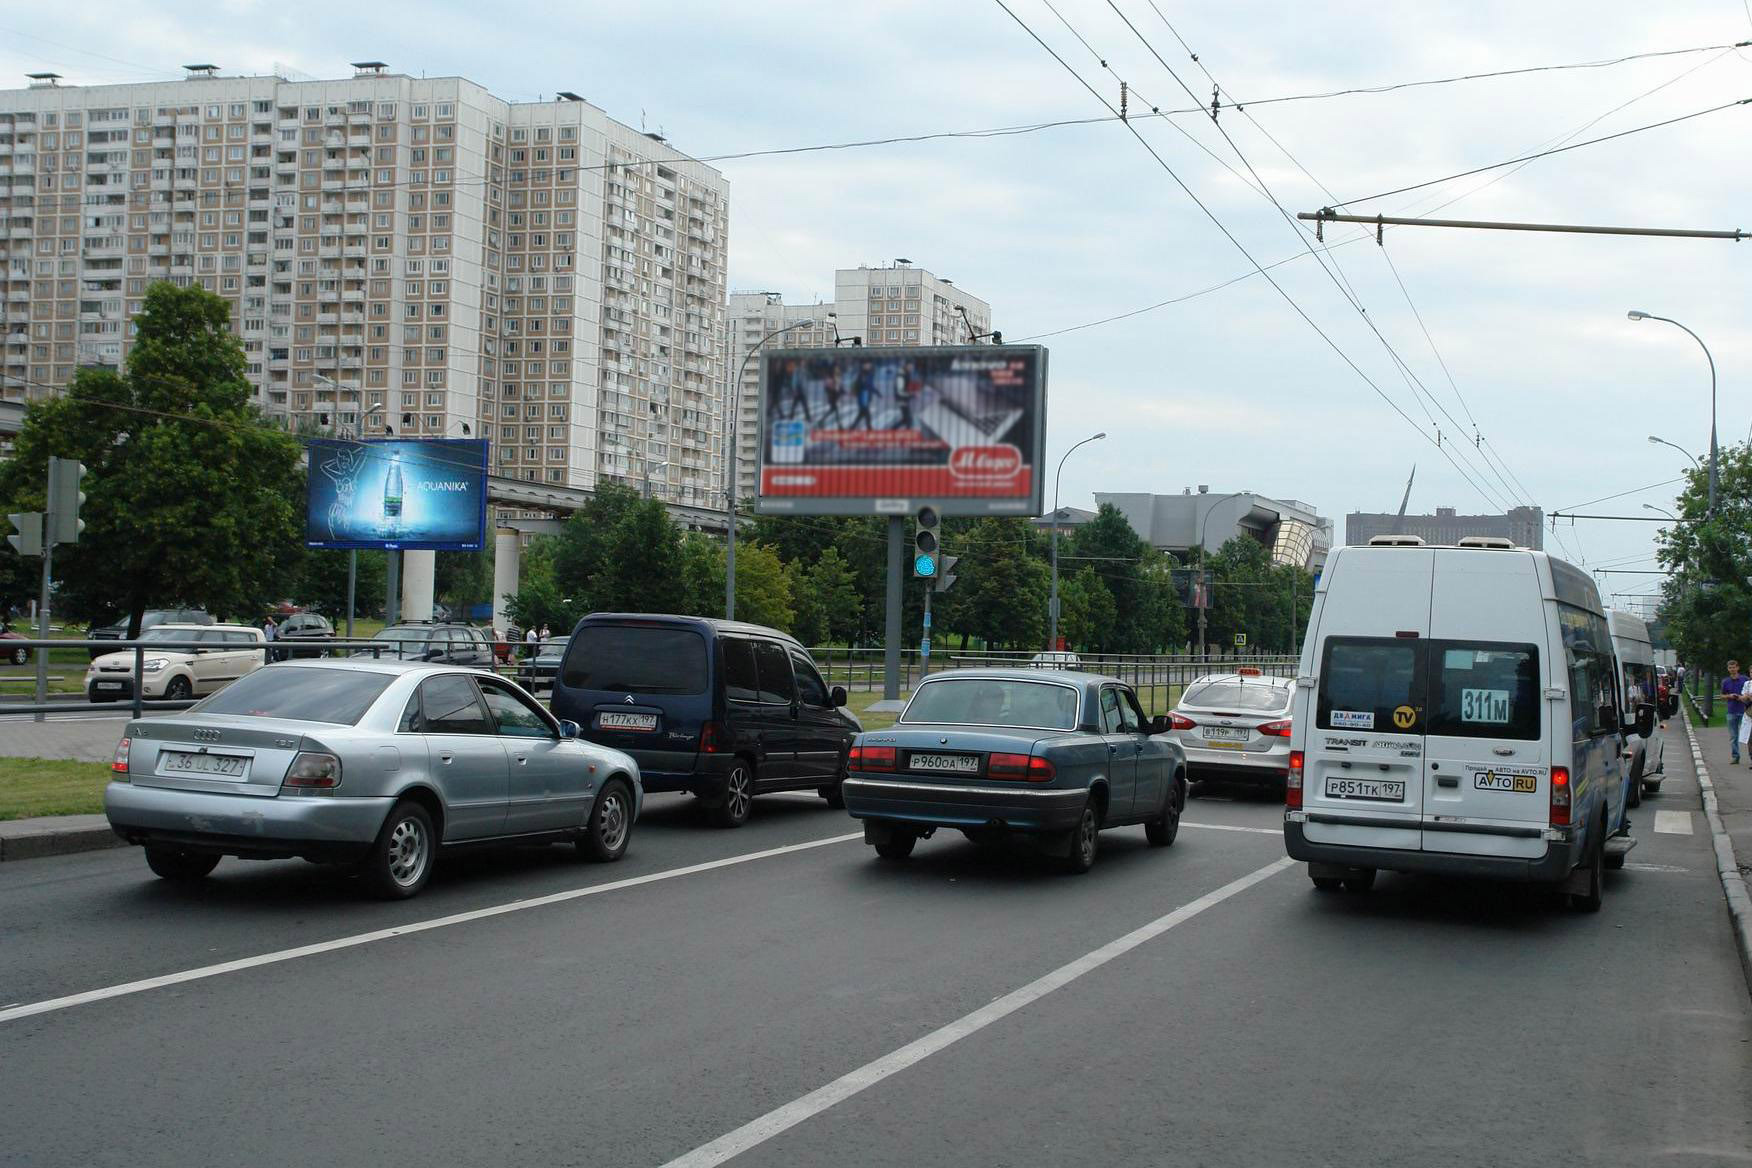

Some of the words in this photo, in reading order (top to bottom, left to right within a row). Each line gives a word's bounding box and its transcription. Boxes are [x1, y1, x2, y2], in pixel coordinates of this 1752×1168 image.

[417, 481, 467, 492] AQUANIKA
[1464, 691, 1507, 720] 311М
[1396, 711, 1414, 724] TV
[1325, 737, 1368, 747] TRANSIT
[959, 757, 976, 766] 197
[1331, 781, 1378, 795] Р851ТК
[1382, 783, 1399, 793] 197
[1516, 779, 1533, 789] RU
